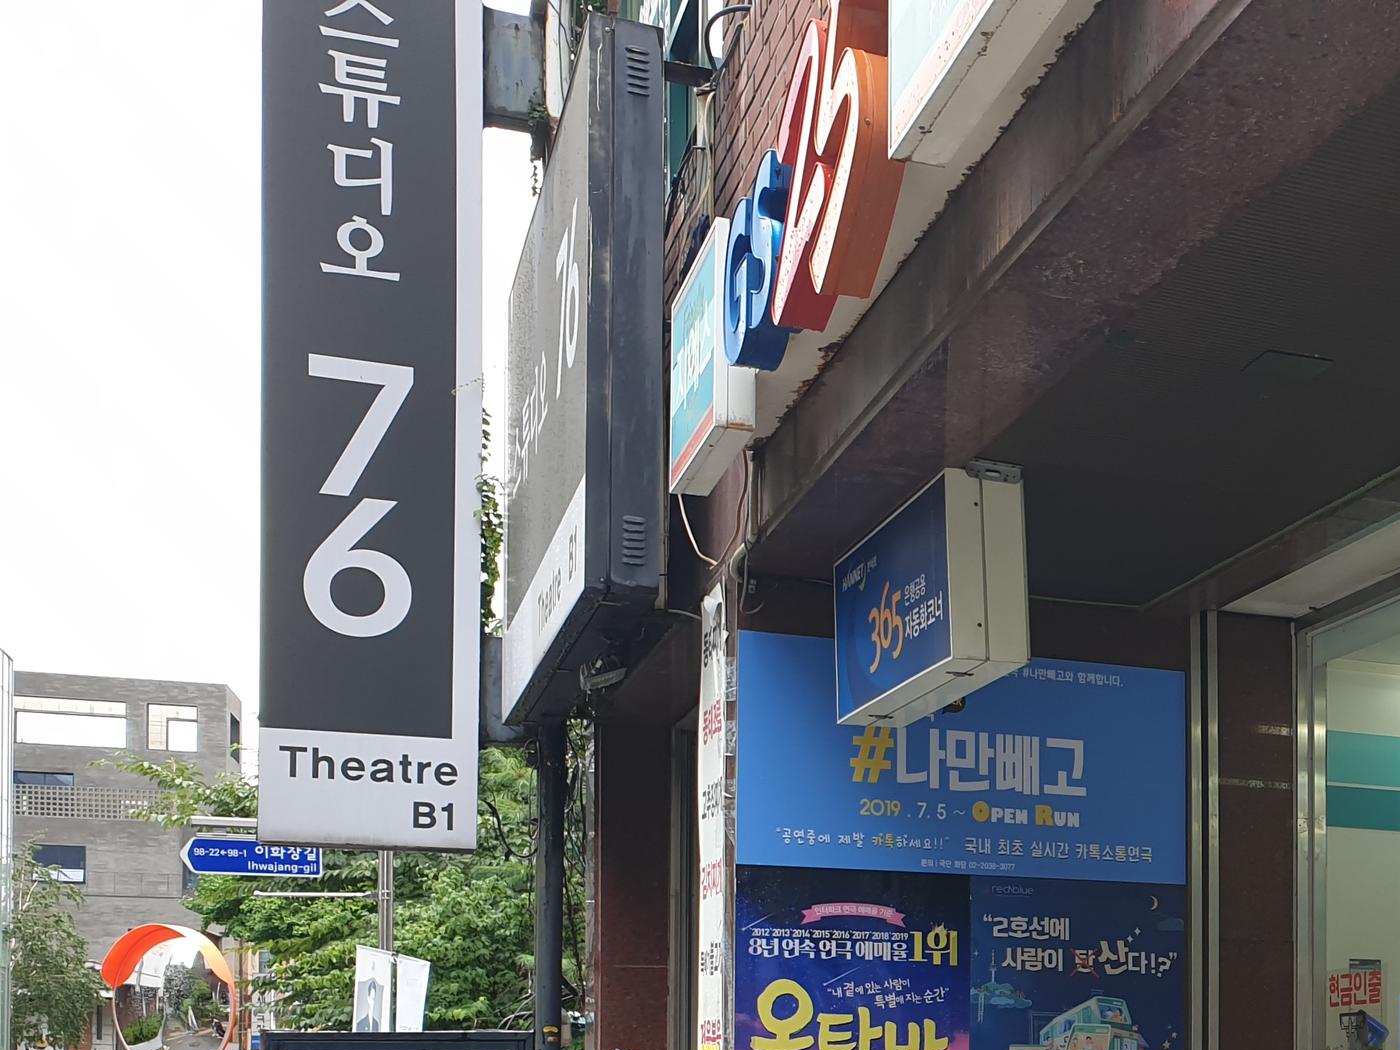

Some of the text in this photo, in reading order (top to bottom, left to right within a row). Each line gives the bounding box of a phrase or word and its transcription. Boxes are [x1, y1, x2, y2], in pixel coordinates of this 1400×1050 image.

[318, 0, 401, 282] 스튜디오
[302, 353, 414, 637] 76
[904, 574, 926, 606] 은행공용
[868, 581, 902, 673] 365
[904, 591, 943, 639] 자동화코너
[278, 745, 458, 786] Theatre
[849, 726, 1087, 797] #나만빼고
[412, 801, 454, 831] B1
[972, 801, 1080, 828] OPEN RUN
[247, 861, 317, 874] Ihwajang-gil
[254, 846, 317, 862] 이화장길
[964, 836, 1153, 863] 국내 최초 실시간 카톡소통연극
[749, 928, 958, 966] 8년 연속 연극 예매율 1위
[1002, 948, 1063, 972] 사람이
[1328, 969, 1382, 1008] 현금인출
